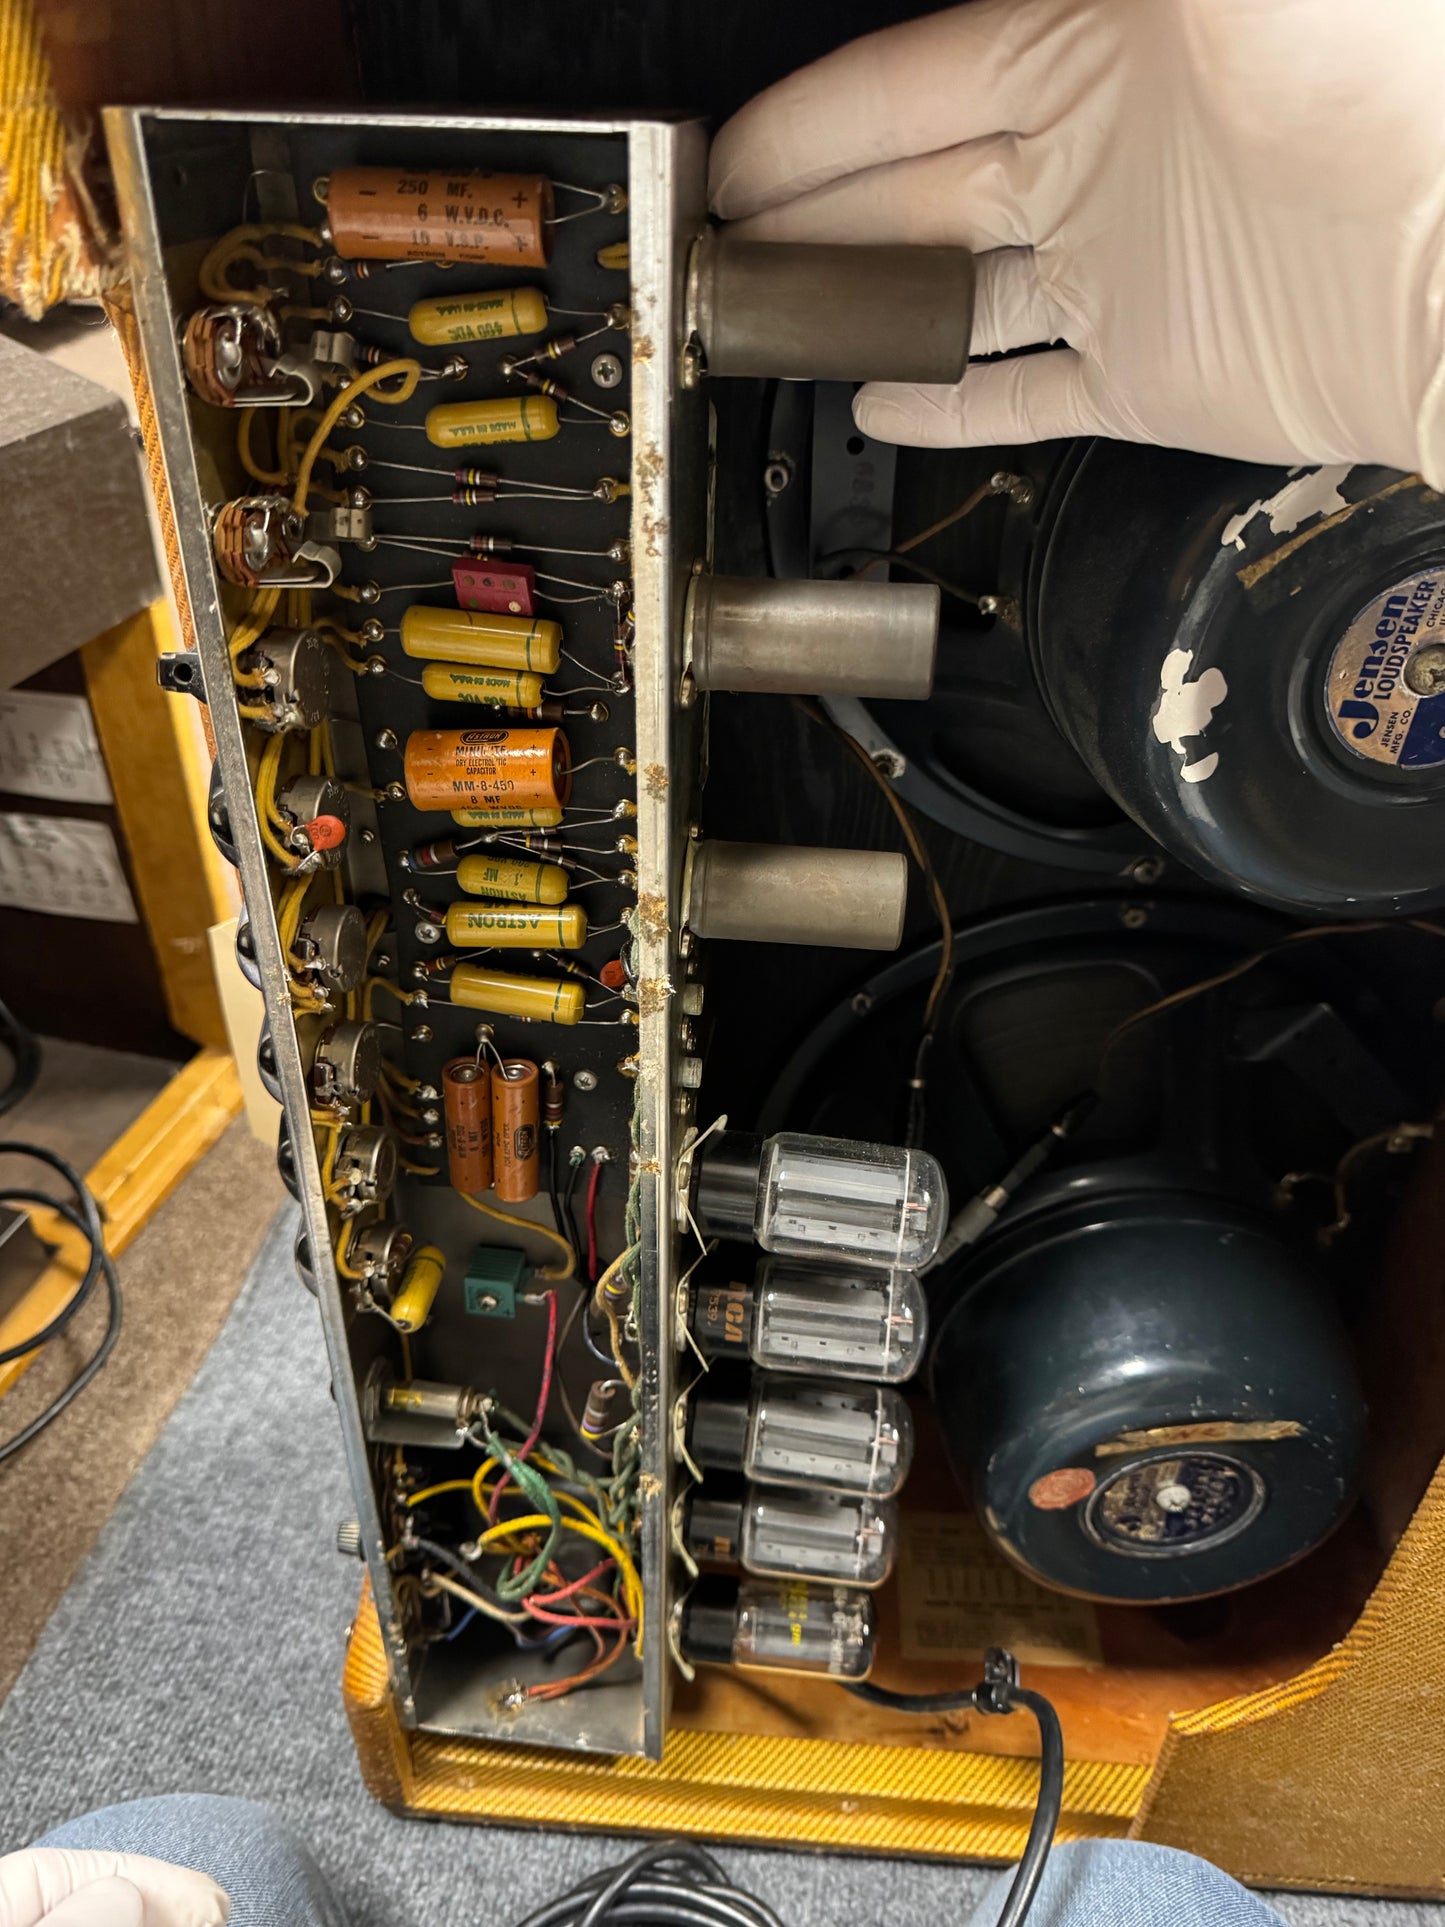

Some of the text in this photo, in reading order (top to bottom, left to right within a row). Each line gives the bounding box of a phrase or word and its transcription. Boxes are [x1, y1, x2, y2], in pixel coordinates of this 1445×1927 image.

[397, 179, 473, 199] 250 MF.
[417, 203, 510, 228] 6 W.V.D.C.
[1373, 580, 1438, 700] LOUDSPEAKER
[1337, 595, 1409, 739] Jensen
[1380, 711, 1399, 748] JENSEN
[1390, 706, 1413, 754] MFG. CO.
[455, 758, 467, 767] DRY
[466, 767, 497, 776] CAPACITOR
[452, 780, 515, 793] MM-8-450
[471, 795, 502, 804] 8 MF
[482, 867, 499, 882] MF
[468, 912, 541, 929] ASTRON
[724, 1281, 747, 1343] RCA
